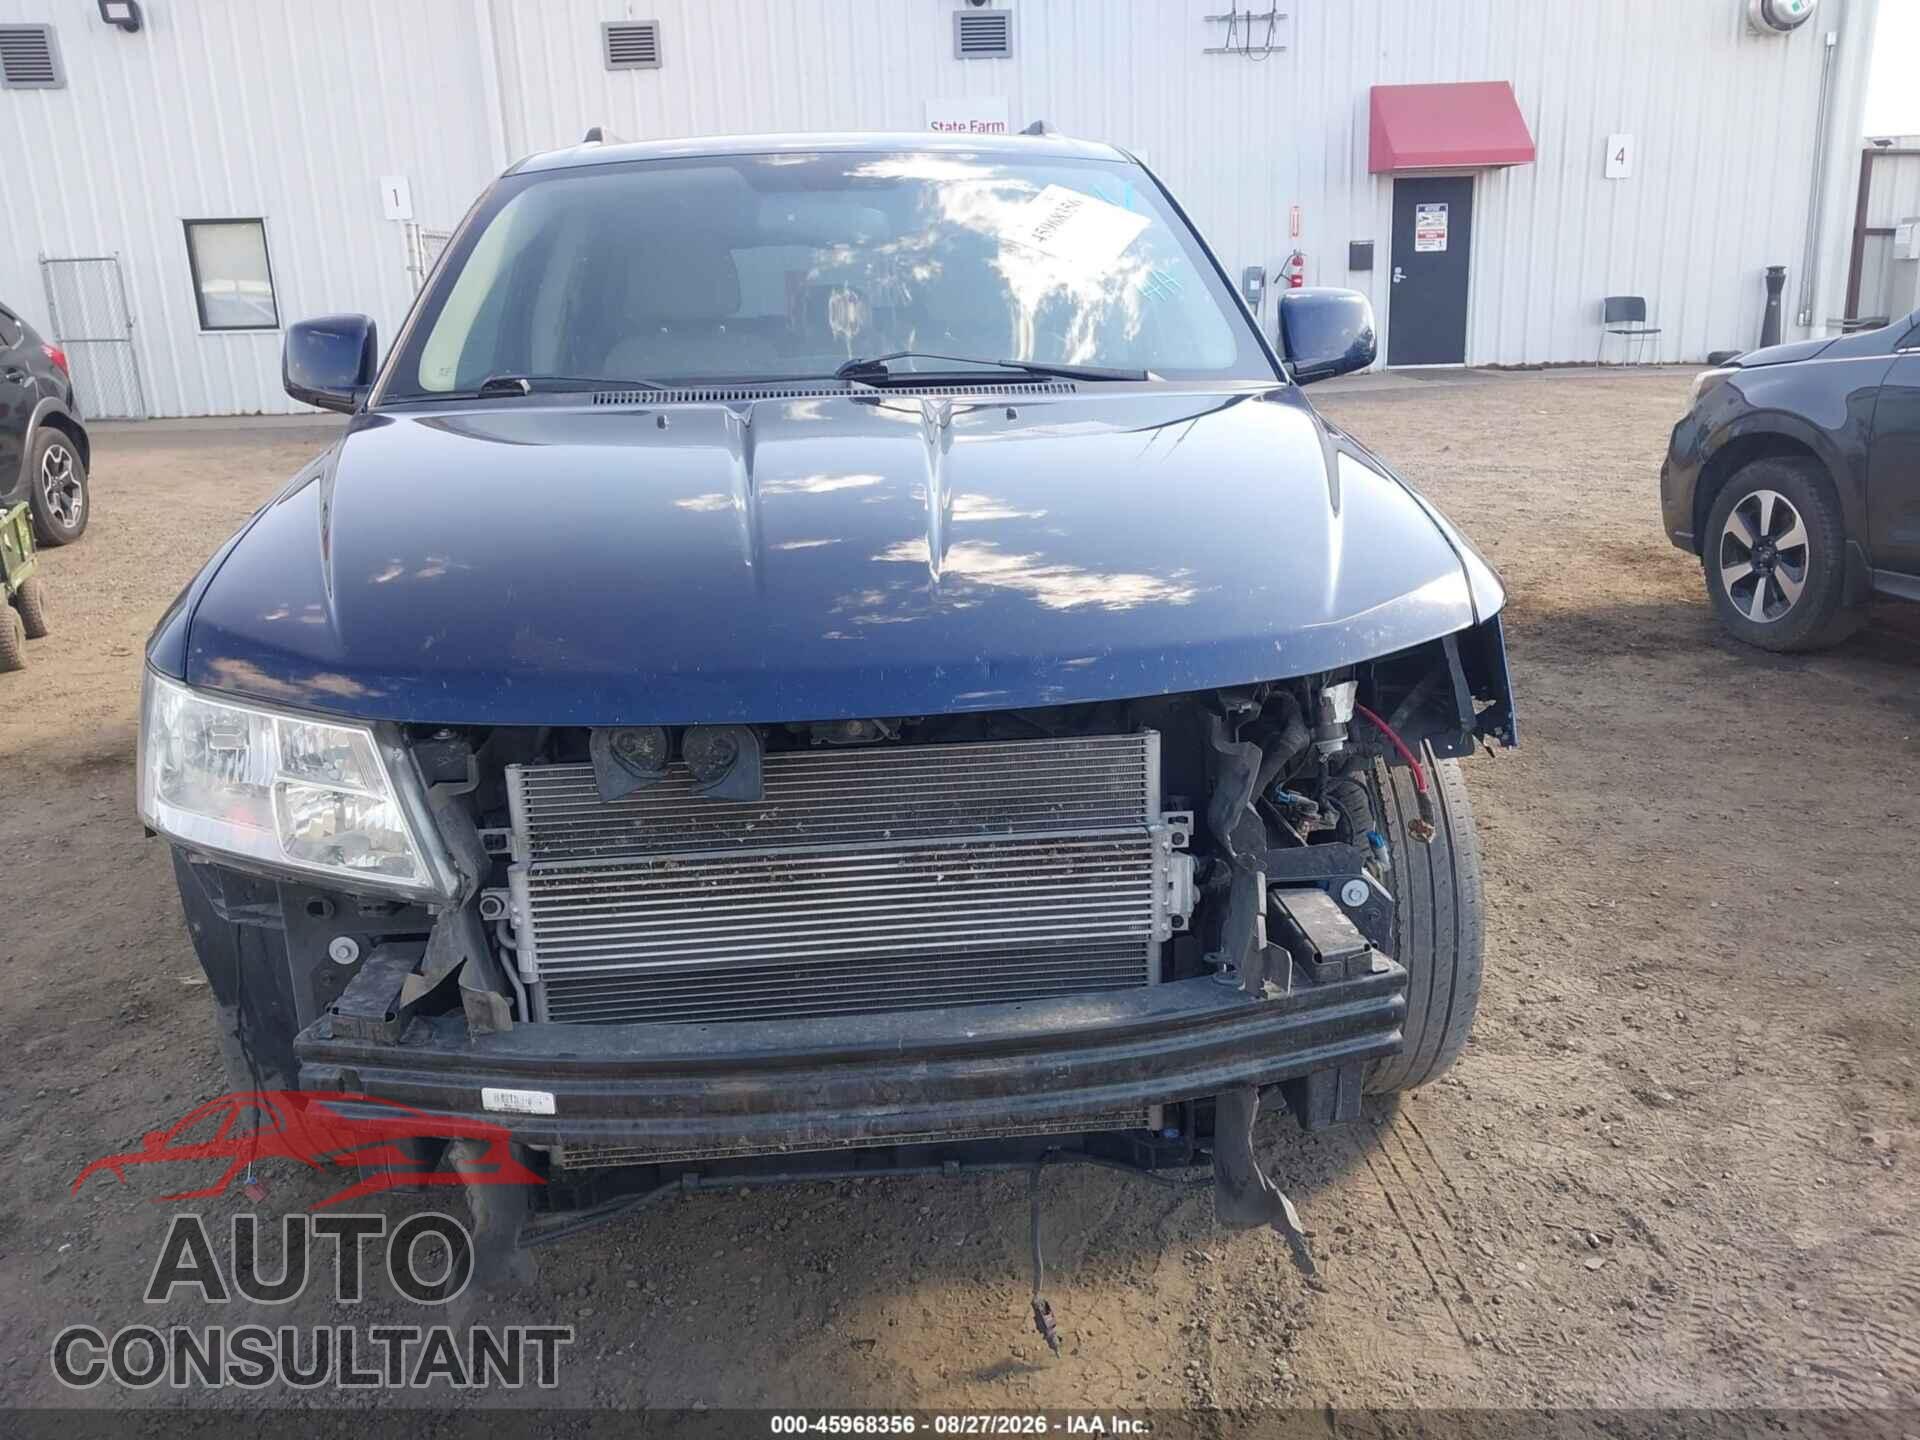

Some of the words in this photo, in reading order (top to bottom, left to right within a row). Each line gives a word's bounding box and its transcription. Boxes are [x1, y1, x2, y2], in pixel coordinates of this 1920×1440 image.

[930, 120, 966, 132] State
[969, 120, 1005, 133] Farm
[1614, 146, 1625, 165] 4
[392, 188, 399, 207] 1
